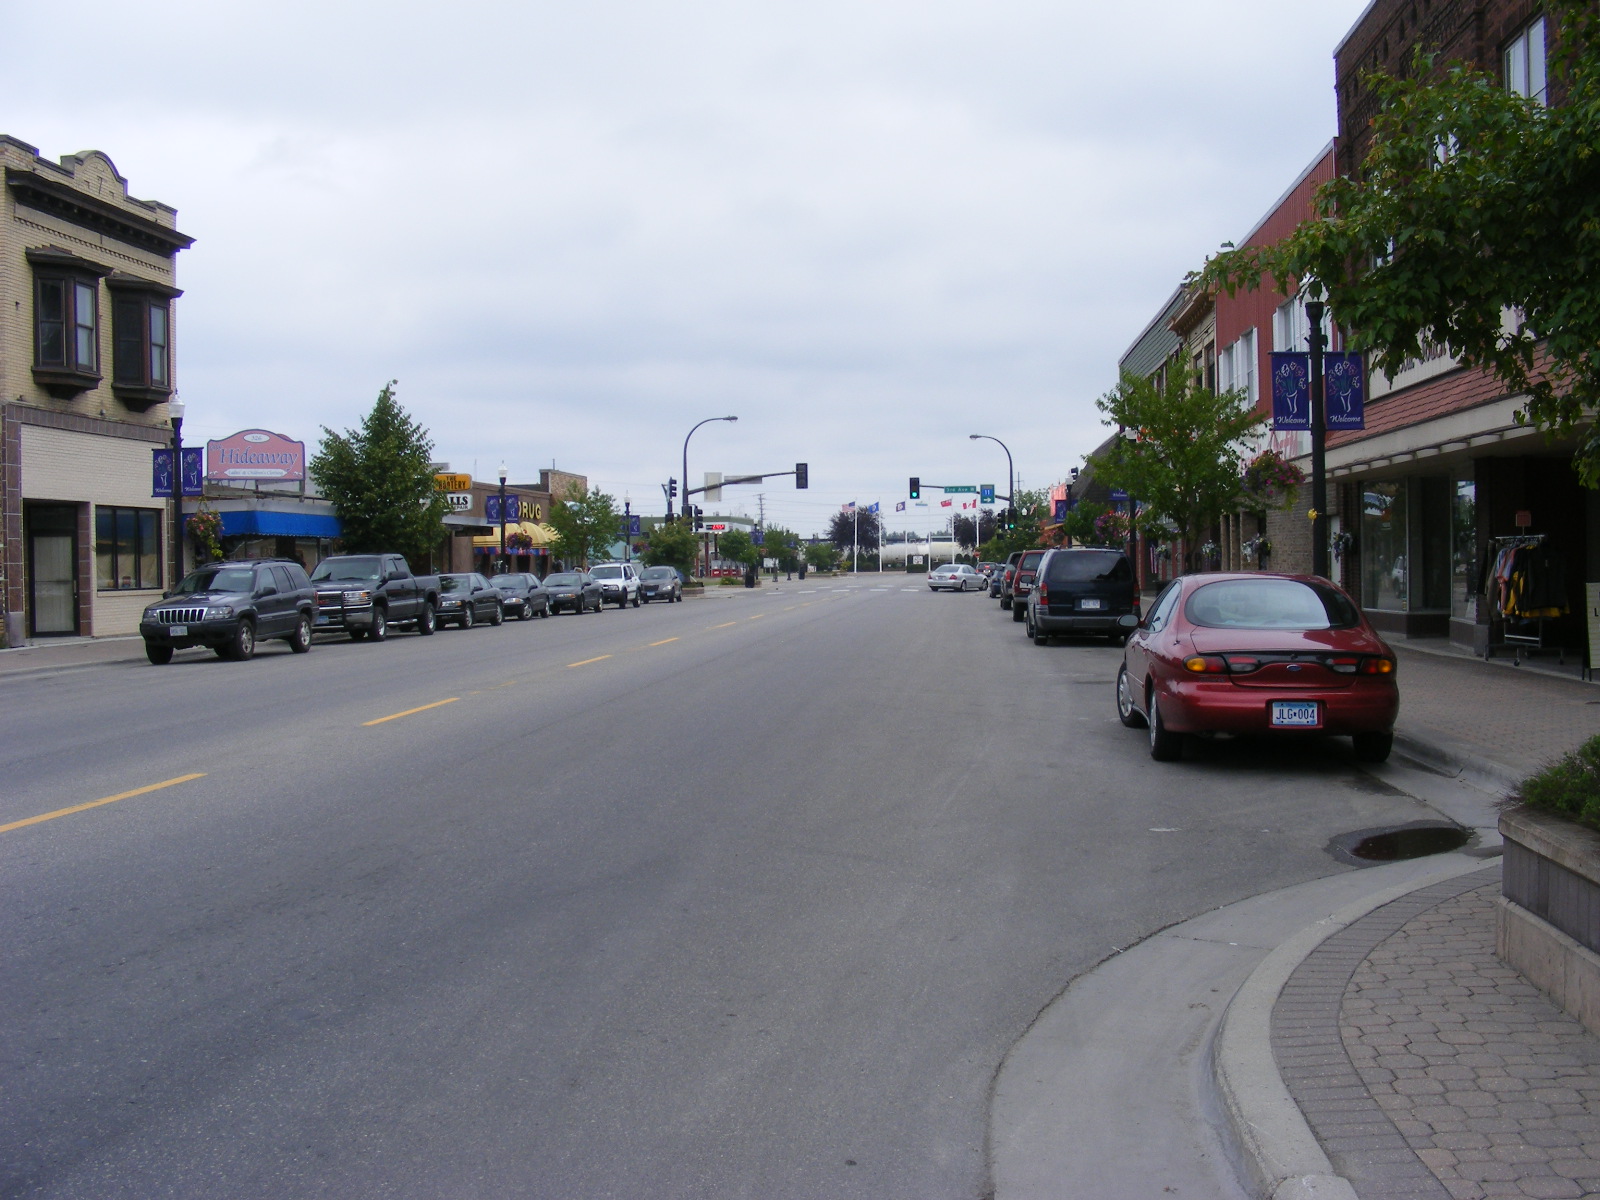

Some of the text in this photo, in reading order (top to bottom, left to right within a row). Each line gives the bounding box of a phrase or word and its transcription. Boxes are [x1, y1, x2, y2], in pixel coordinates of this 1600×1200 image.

[1277, 415, 1307, 424] Welcome
[1330, 414, 1361, 423] Welcome
[220, 447, 298, 471] Hideaway
